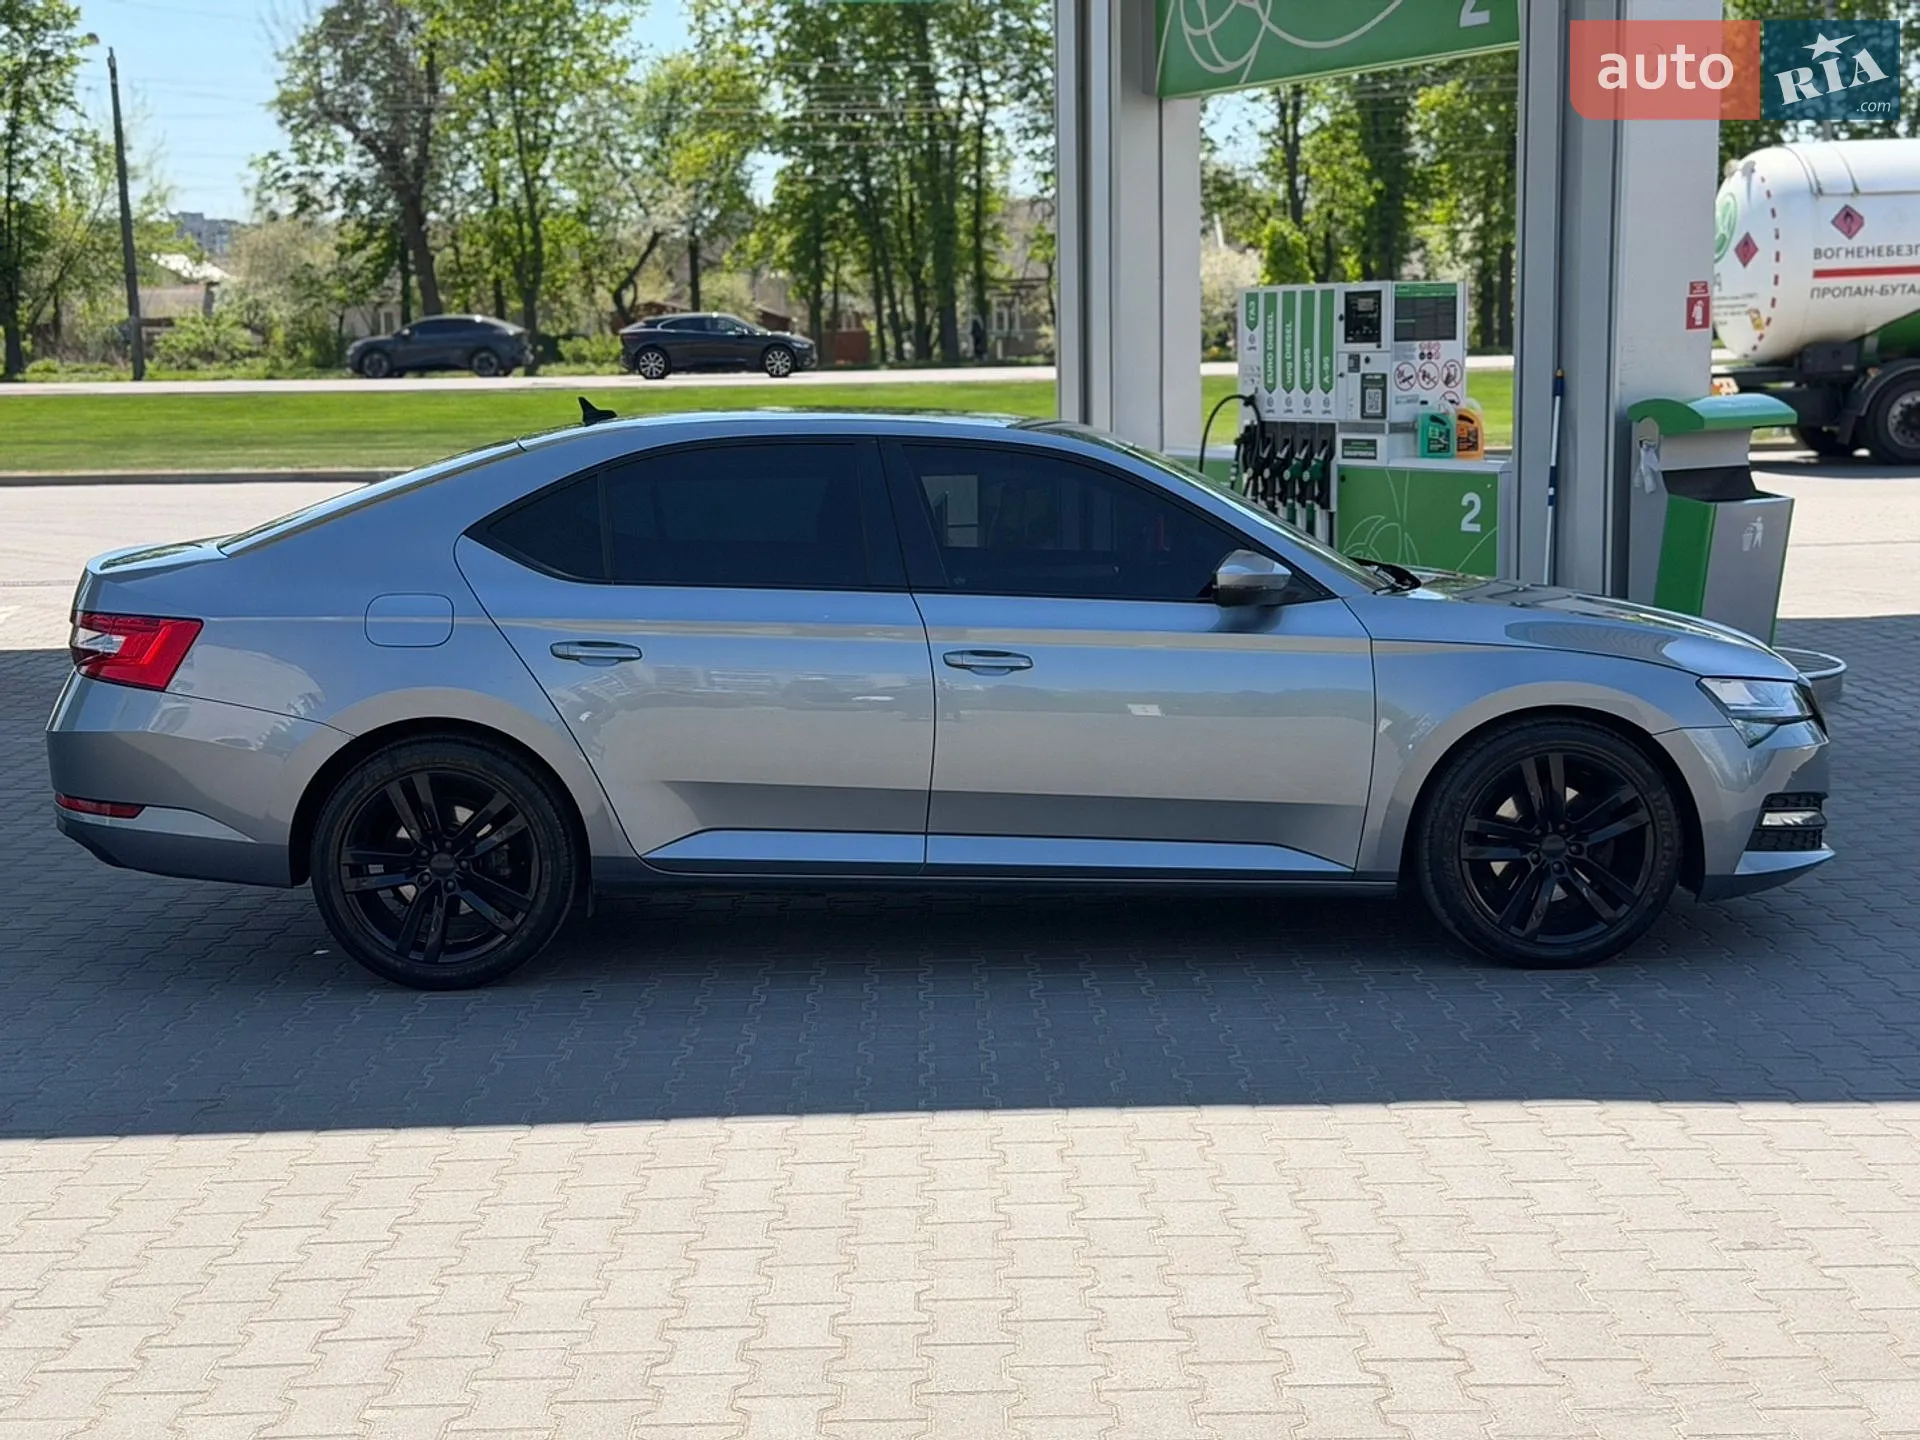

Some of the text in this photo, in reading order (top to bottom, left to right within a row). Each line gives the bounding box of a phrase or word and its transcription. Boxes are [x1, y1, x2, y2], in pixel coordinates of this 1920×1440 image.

[1810, 284, 1920, 299] ПРОПАН-БУТА
[1266, 312, 1274, 384] EURO DIESEL
[1461, 492, 1481, 532] 2
